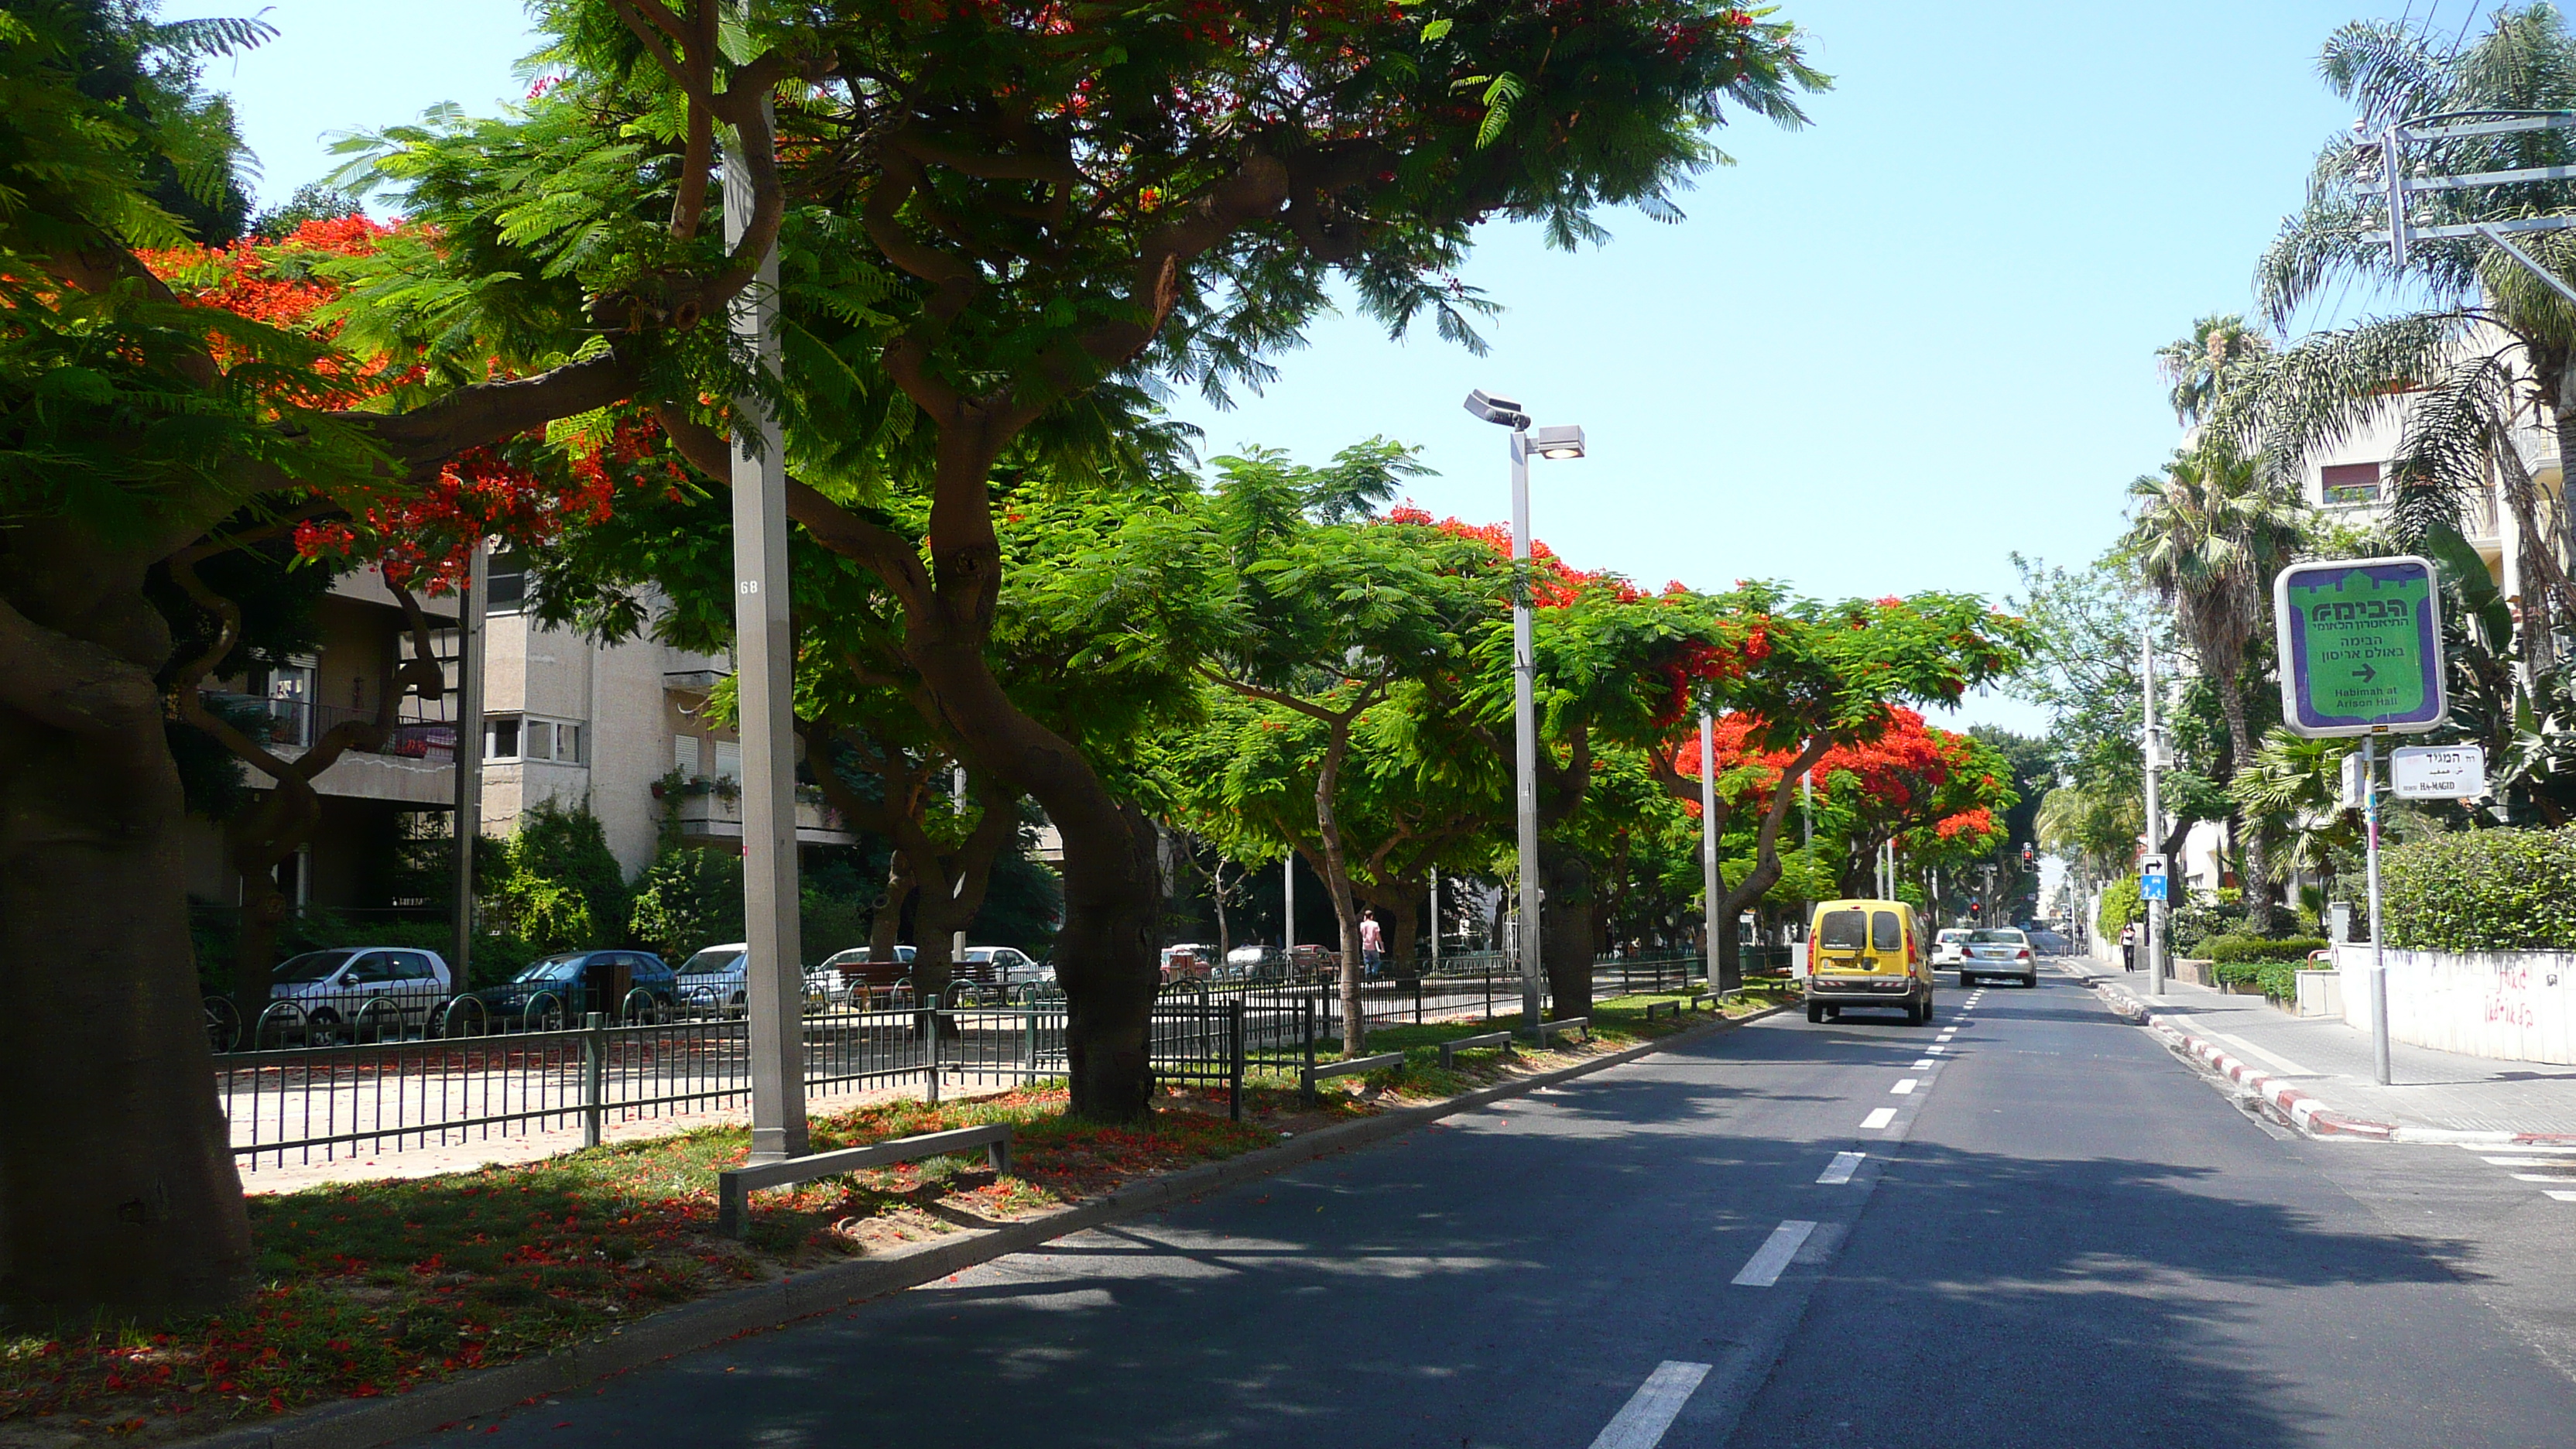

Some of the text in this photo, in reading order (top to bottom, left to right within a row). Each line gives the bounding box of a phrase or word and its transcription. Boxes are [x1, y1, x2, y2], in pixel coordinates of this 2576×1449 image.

[740, 580, 758, 594] 68
[2311, 598, 2408, 622] הבימה
[2312, 618, 2409, 632] התיאטרון הלאומי
[2340, 635, 2382, 647] הבימה
[2321, 646, 2404, 663] באולם אריסון
[2334, 687, 2383, 697] Habimah
[2336, 697, 2397, 708] Arison Hall
[2426, 752, 2460, 764] המגיד
[2420, 781, 2455, 791] HA-MAGID
